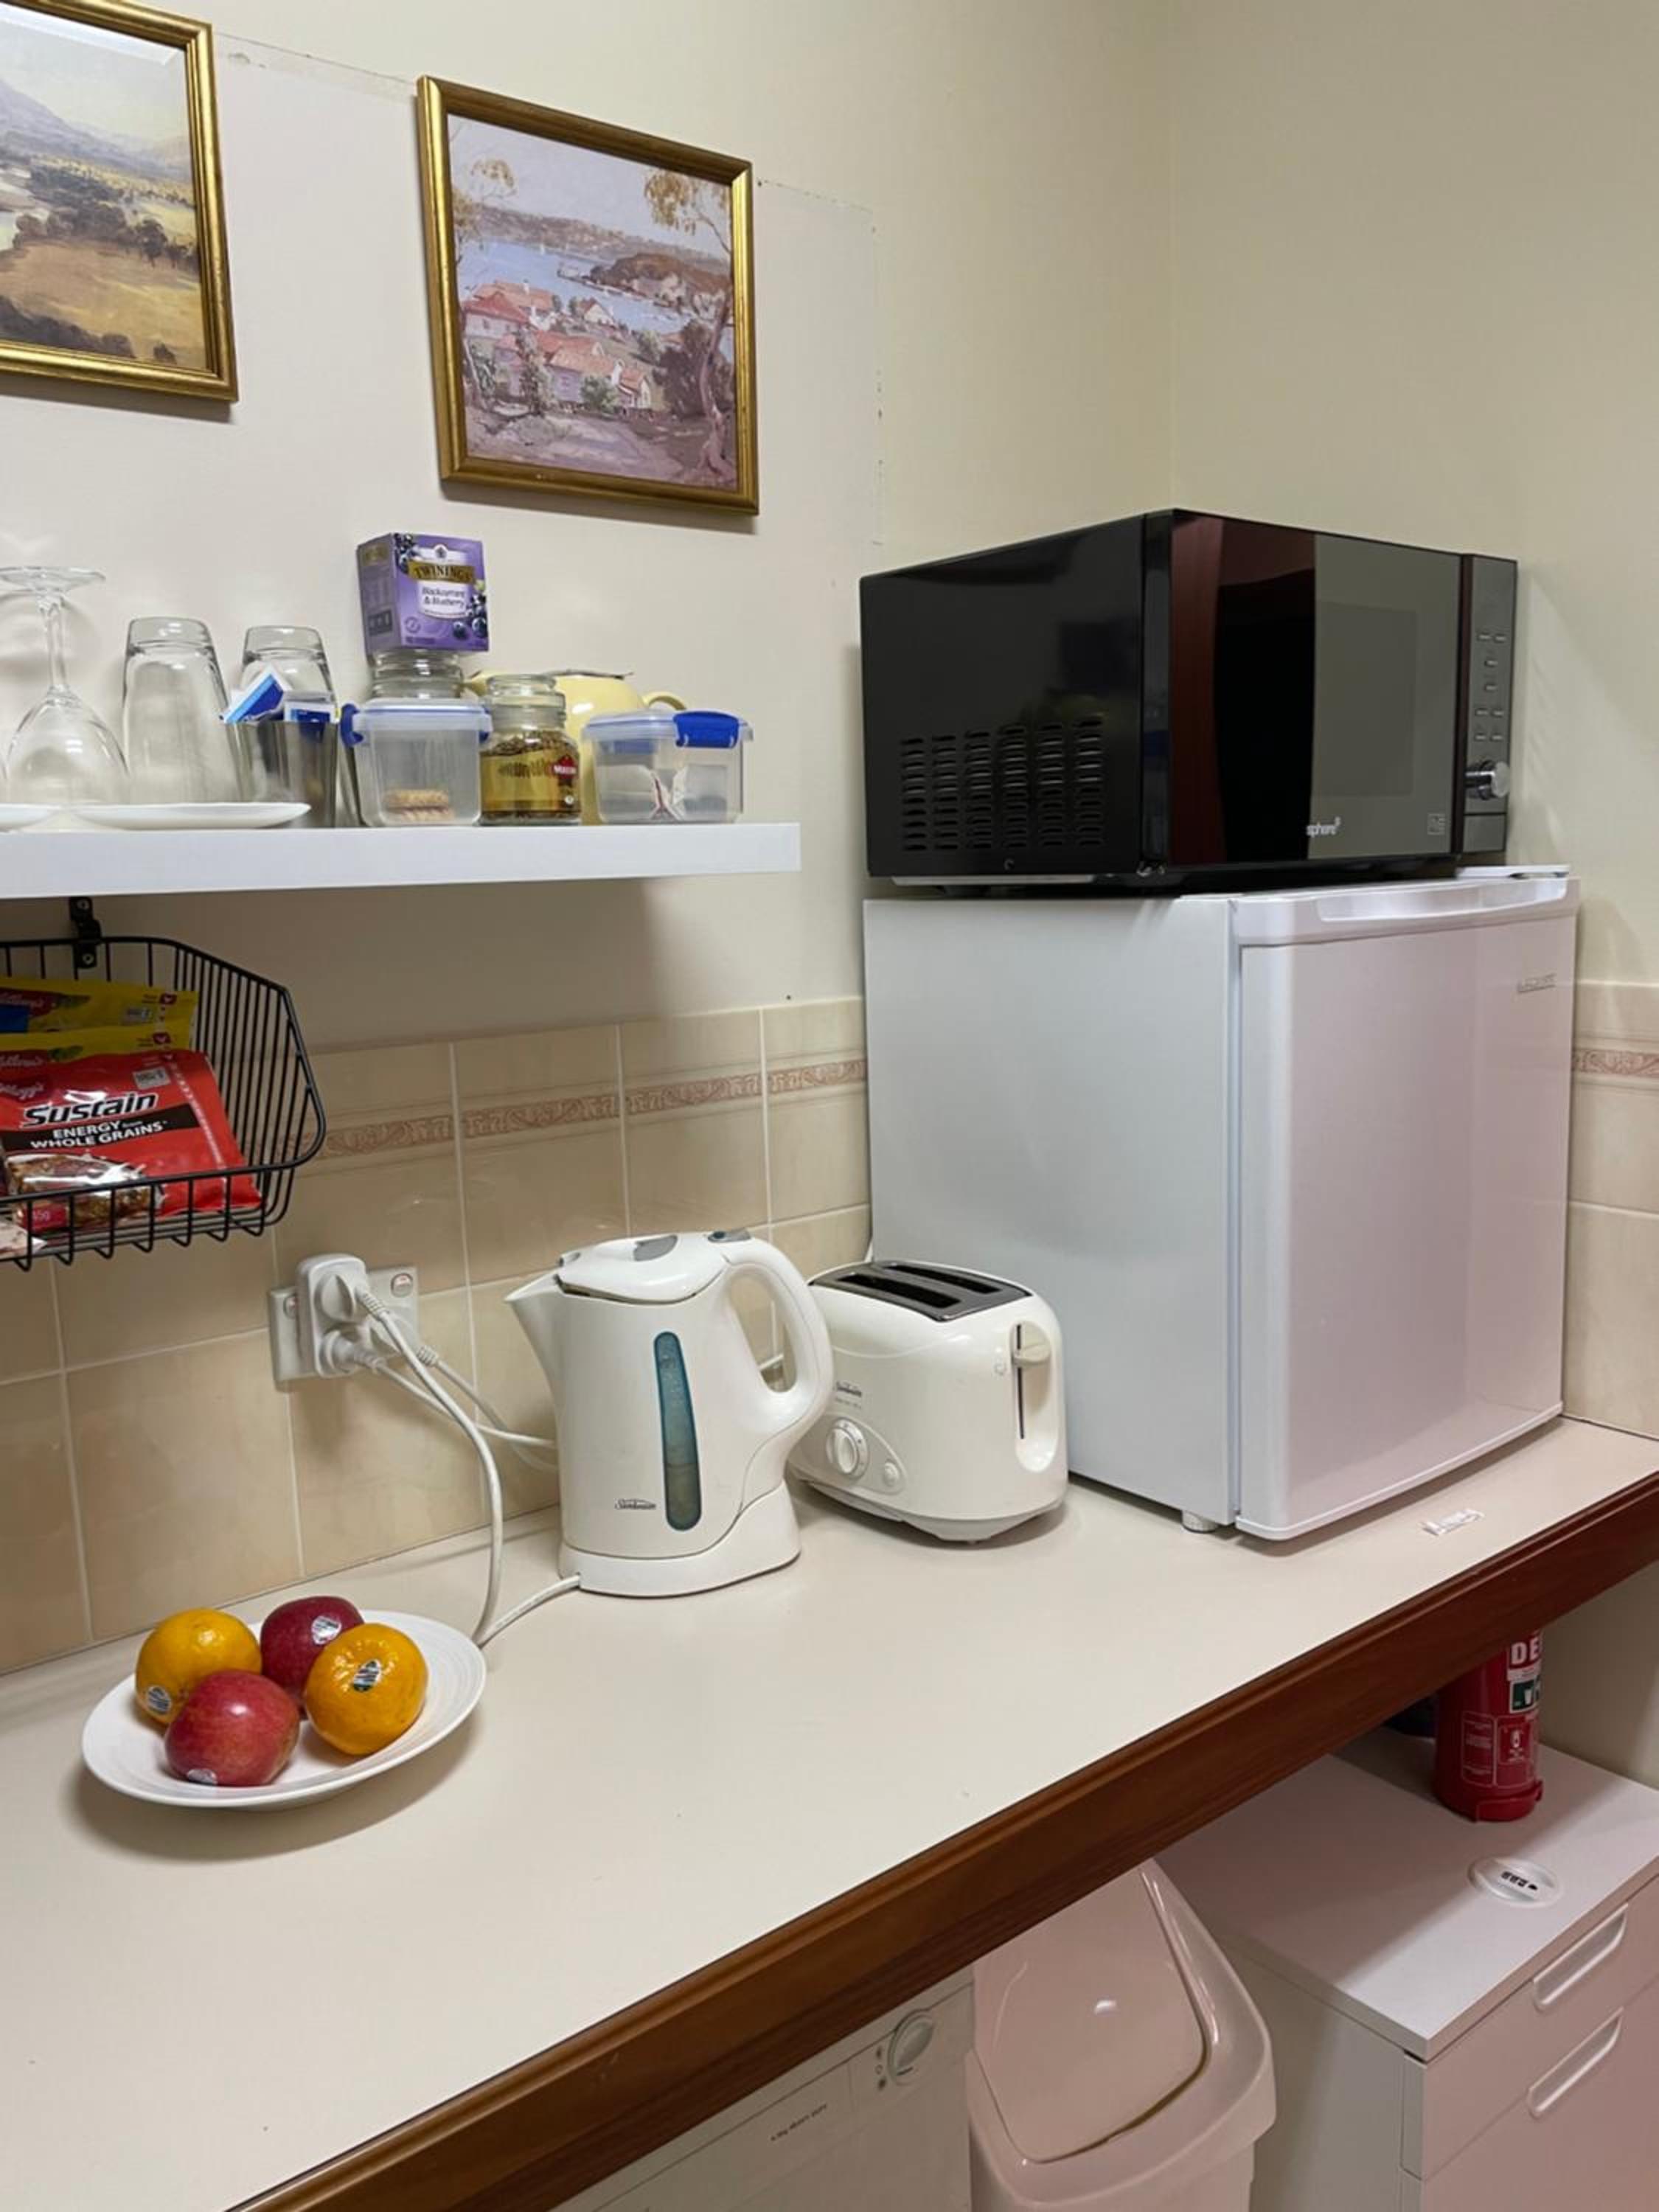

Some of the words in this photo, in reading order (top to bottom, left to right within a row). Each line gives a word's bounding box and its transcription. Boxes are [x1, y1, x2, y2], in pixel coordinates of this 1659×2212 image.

[413, 564, 474, 582] TWININGS
[21, 1092, 159, 1129] Sustain
[30, 1135, 97, 1149] WHOLE
[98, 1122, 164, 1144] GRAINS
[52, 1120, 122, 1140] ENERGY
